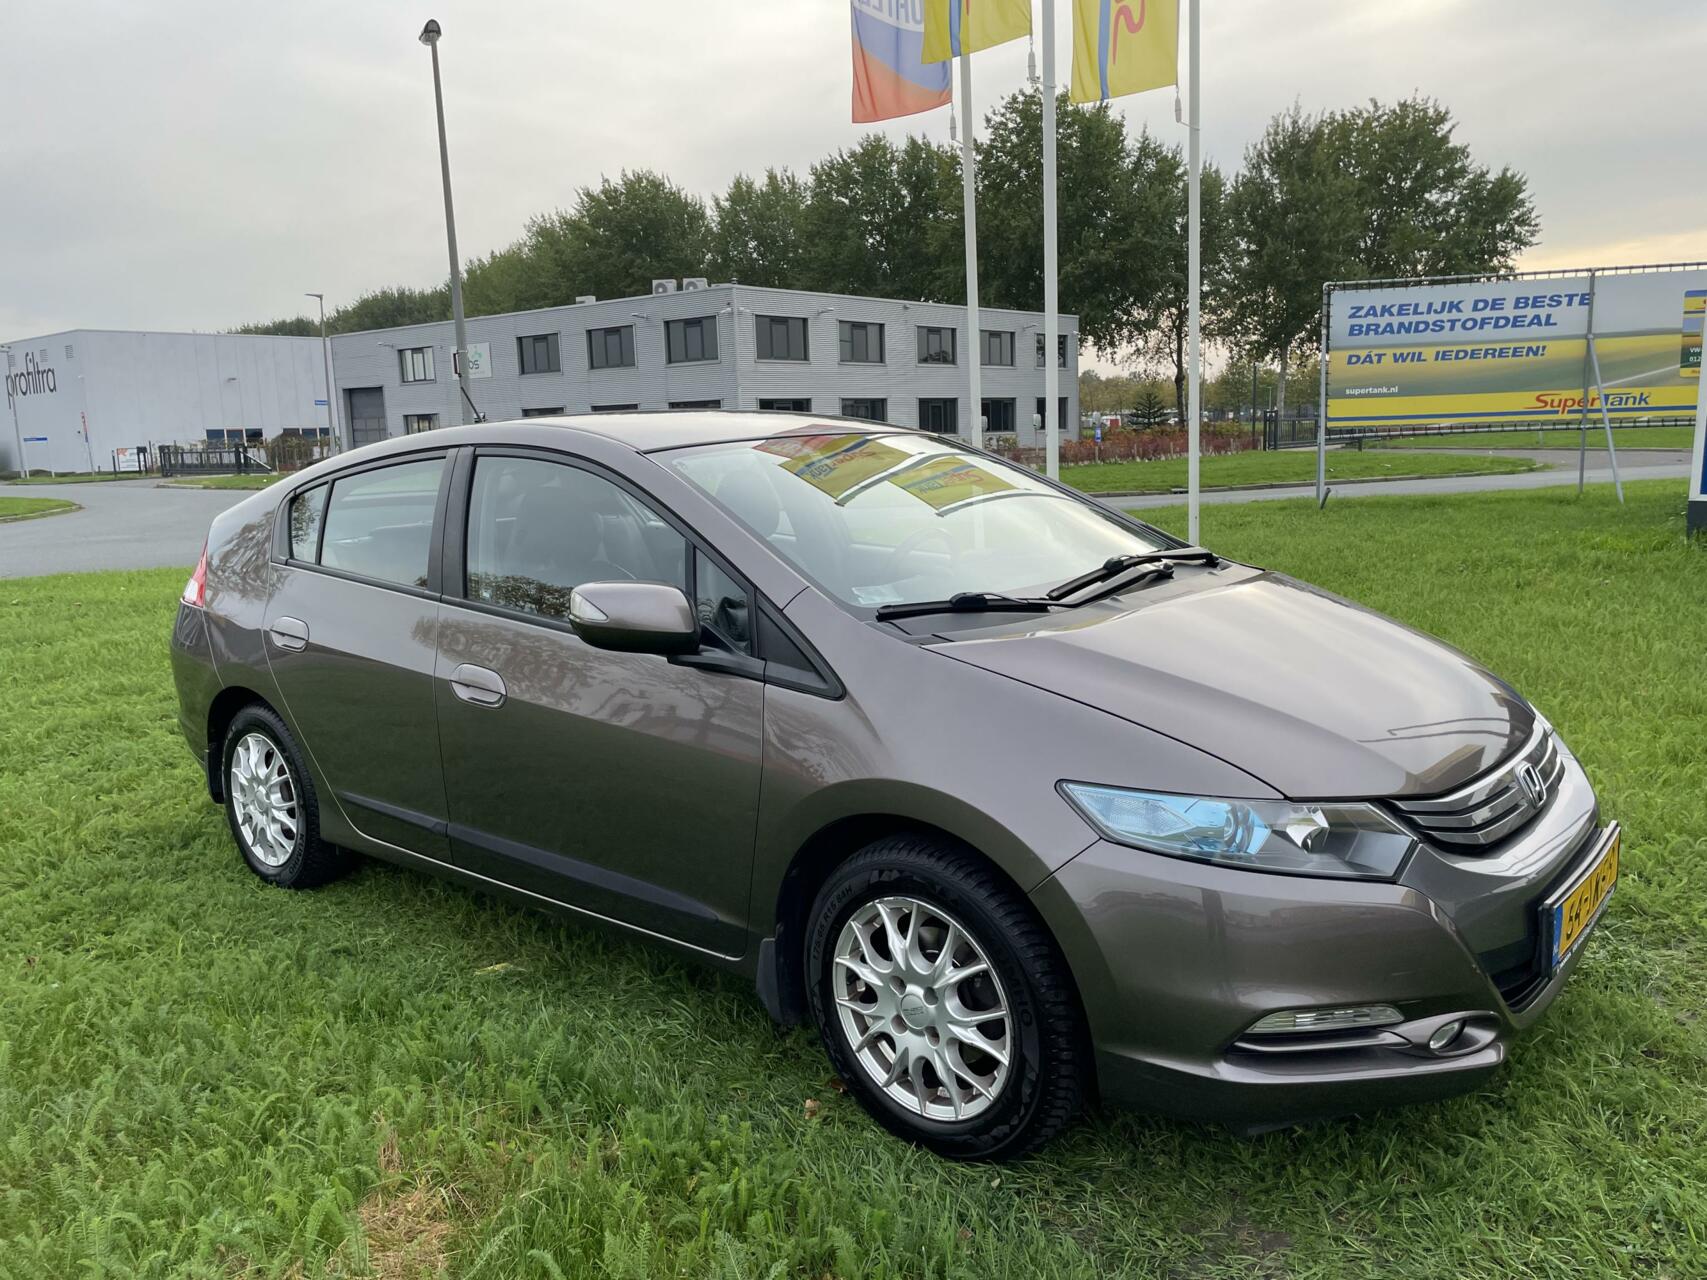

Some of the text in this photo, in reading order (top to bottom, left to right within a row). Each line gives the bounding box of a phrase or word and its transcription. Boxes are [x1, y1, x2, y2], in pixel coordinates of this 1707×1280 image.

[1348, 292, 1591, 319] ZAKELIJK DE BESTE
[1348, 314, 1558, 337] BRANDSTOFDEAL
[1346, 345, 1547, 366] DÁT WIL IEDEREEN!
[5, 351, 57, 410] profiltra
[1345, 385, 1399, 396] supertank.nl
